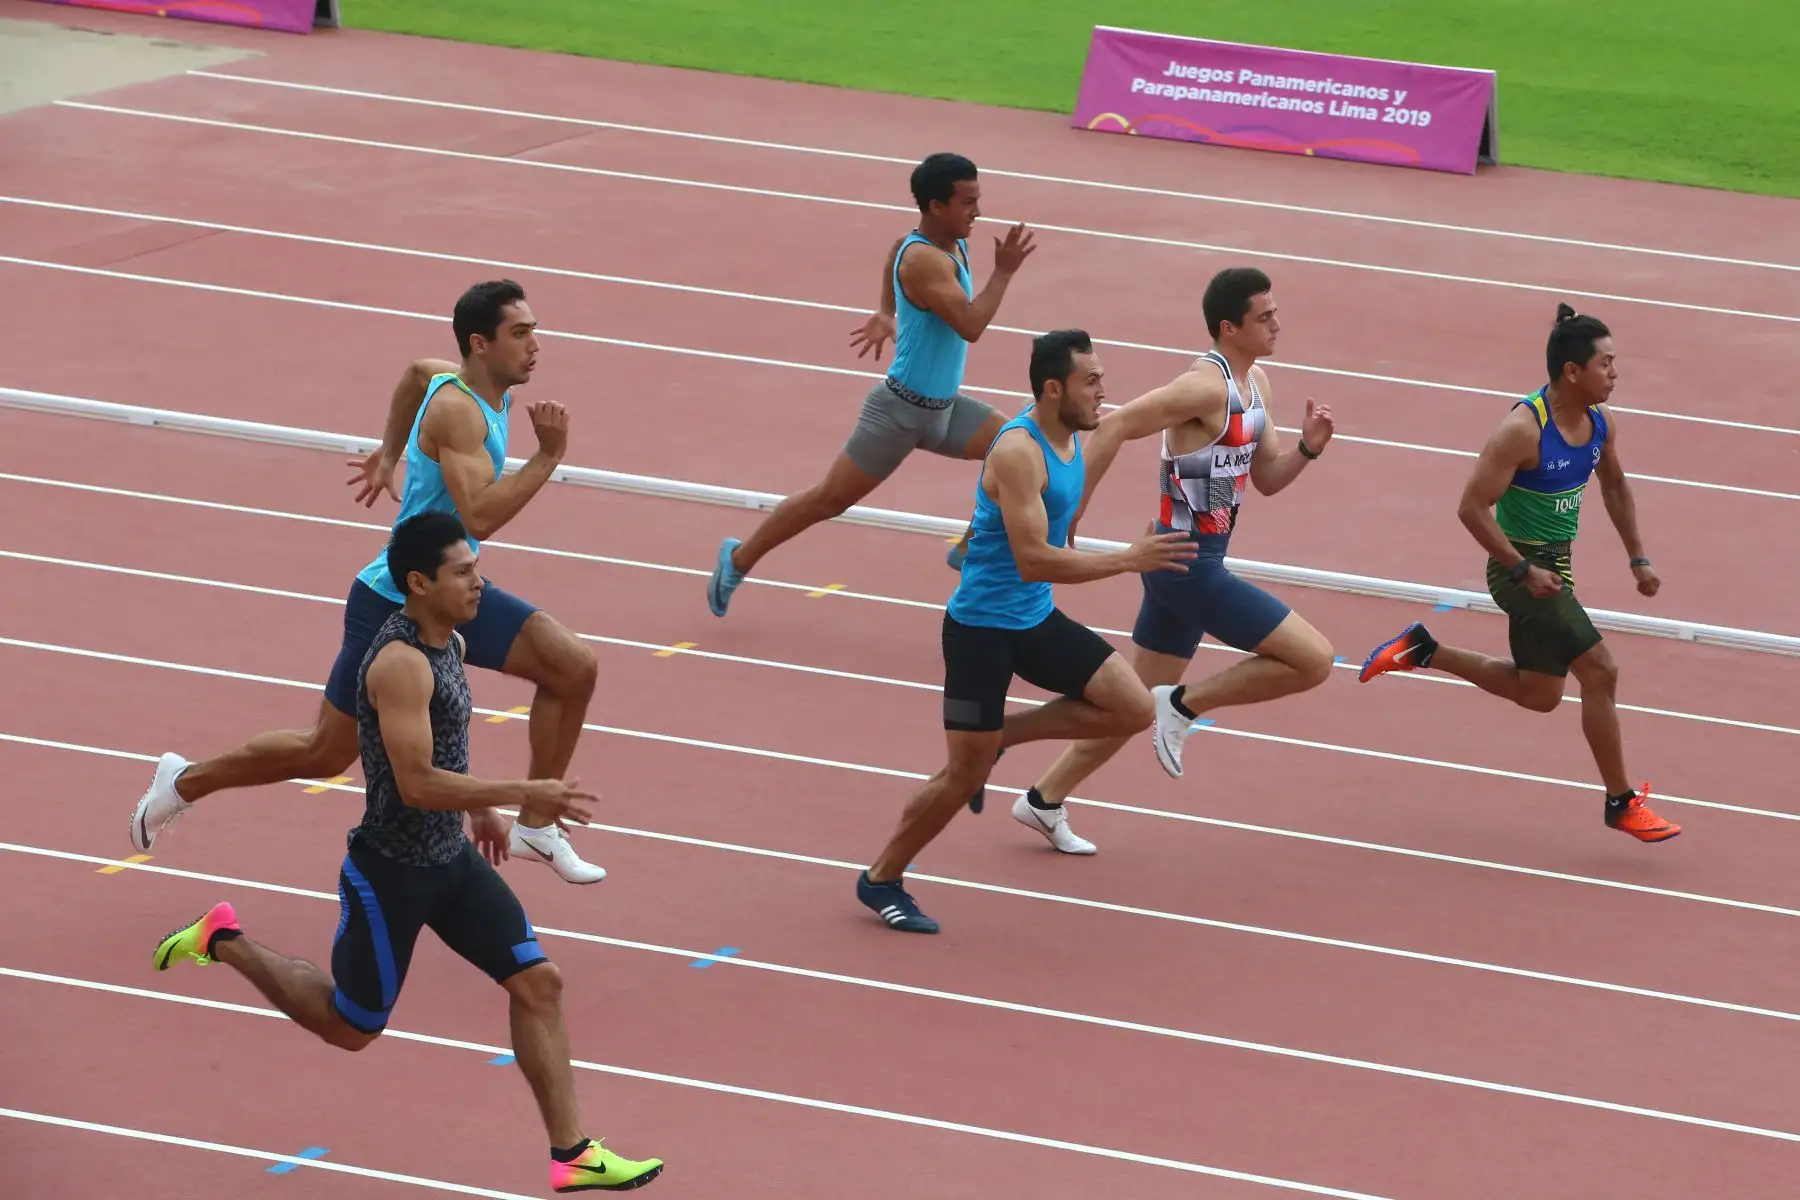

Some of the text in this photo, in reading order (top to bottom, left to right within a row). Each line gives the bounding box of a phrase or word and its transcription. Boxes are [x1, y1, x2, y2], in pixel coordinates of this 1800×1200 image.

[1131, 77, 1432, 127] Parapanamericanos Lima 2019
[1163, 61, 1408, 105] Juegos Panamericanos y
[1215, 454, 1231, 468] LA
